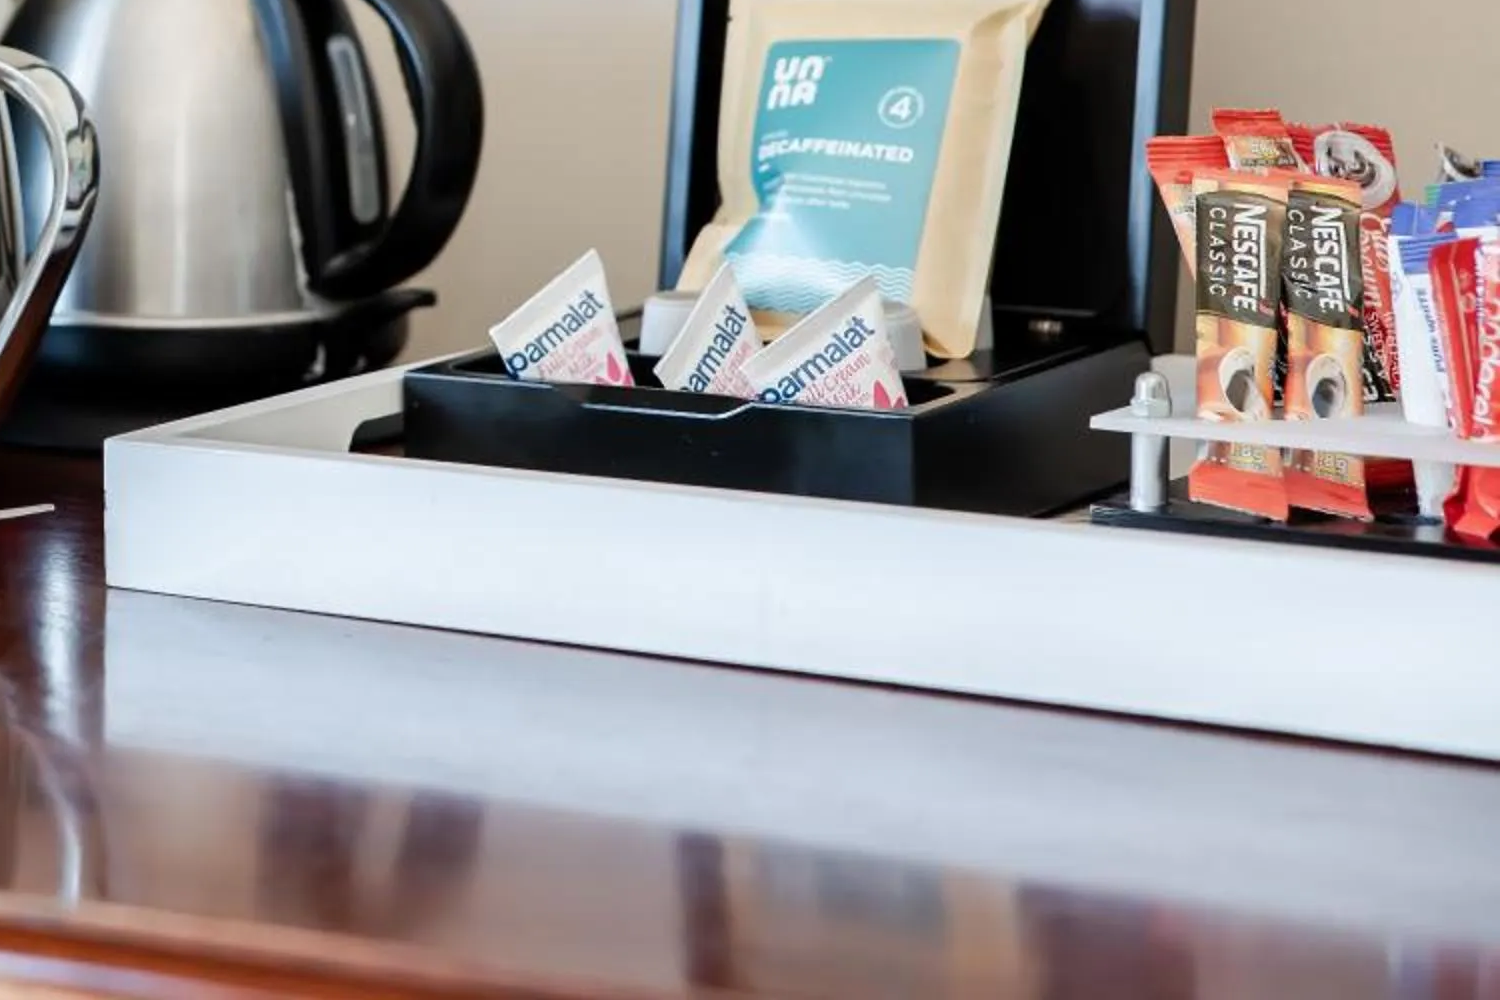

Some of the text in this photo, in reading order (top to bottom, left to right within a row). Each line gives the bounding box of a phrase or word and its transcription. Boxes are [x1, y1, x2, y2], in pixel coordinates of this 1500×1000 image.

[758, 138, 915, 163] DECAFFEINATED
[889, 95, 912, 120] 4
[1209, 206, 1227, 297] CLASSIC
[1288, 209, 1312, 299] CLASSIC
[506, 289, 604, 380] parmalat
[680, 304, 747, 393] armalat
